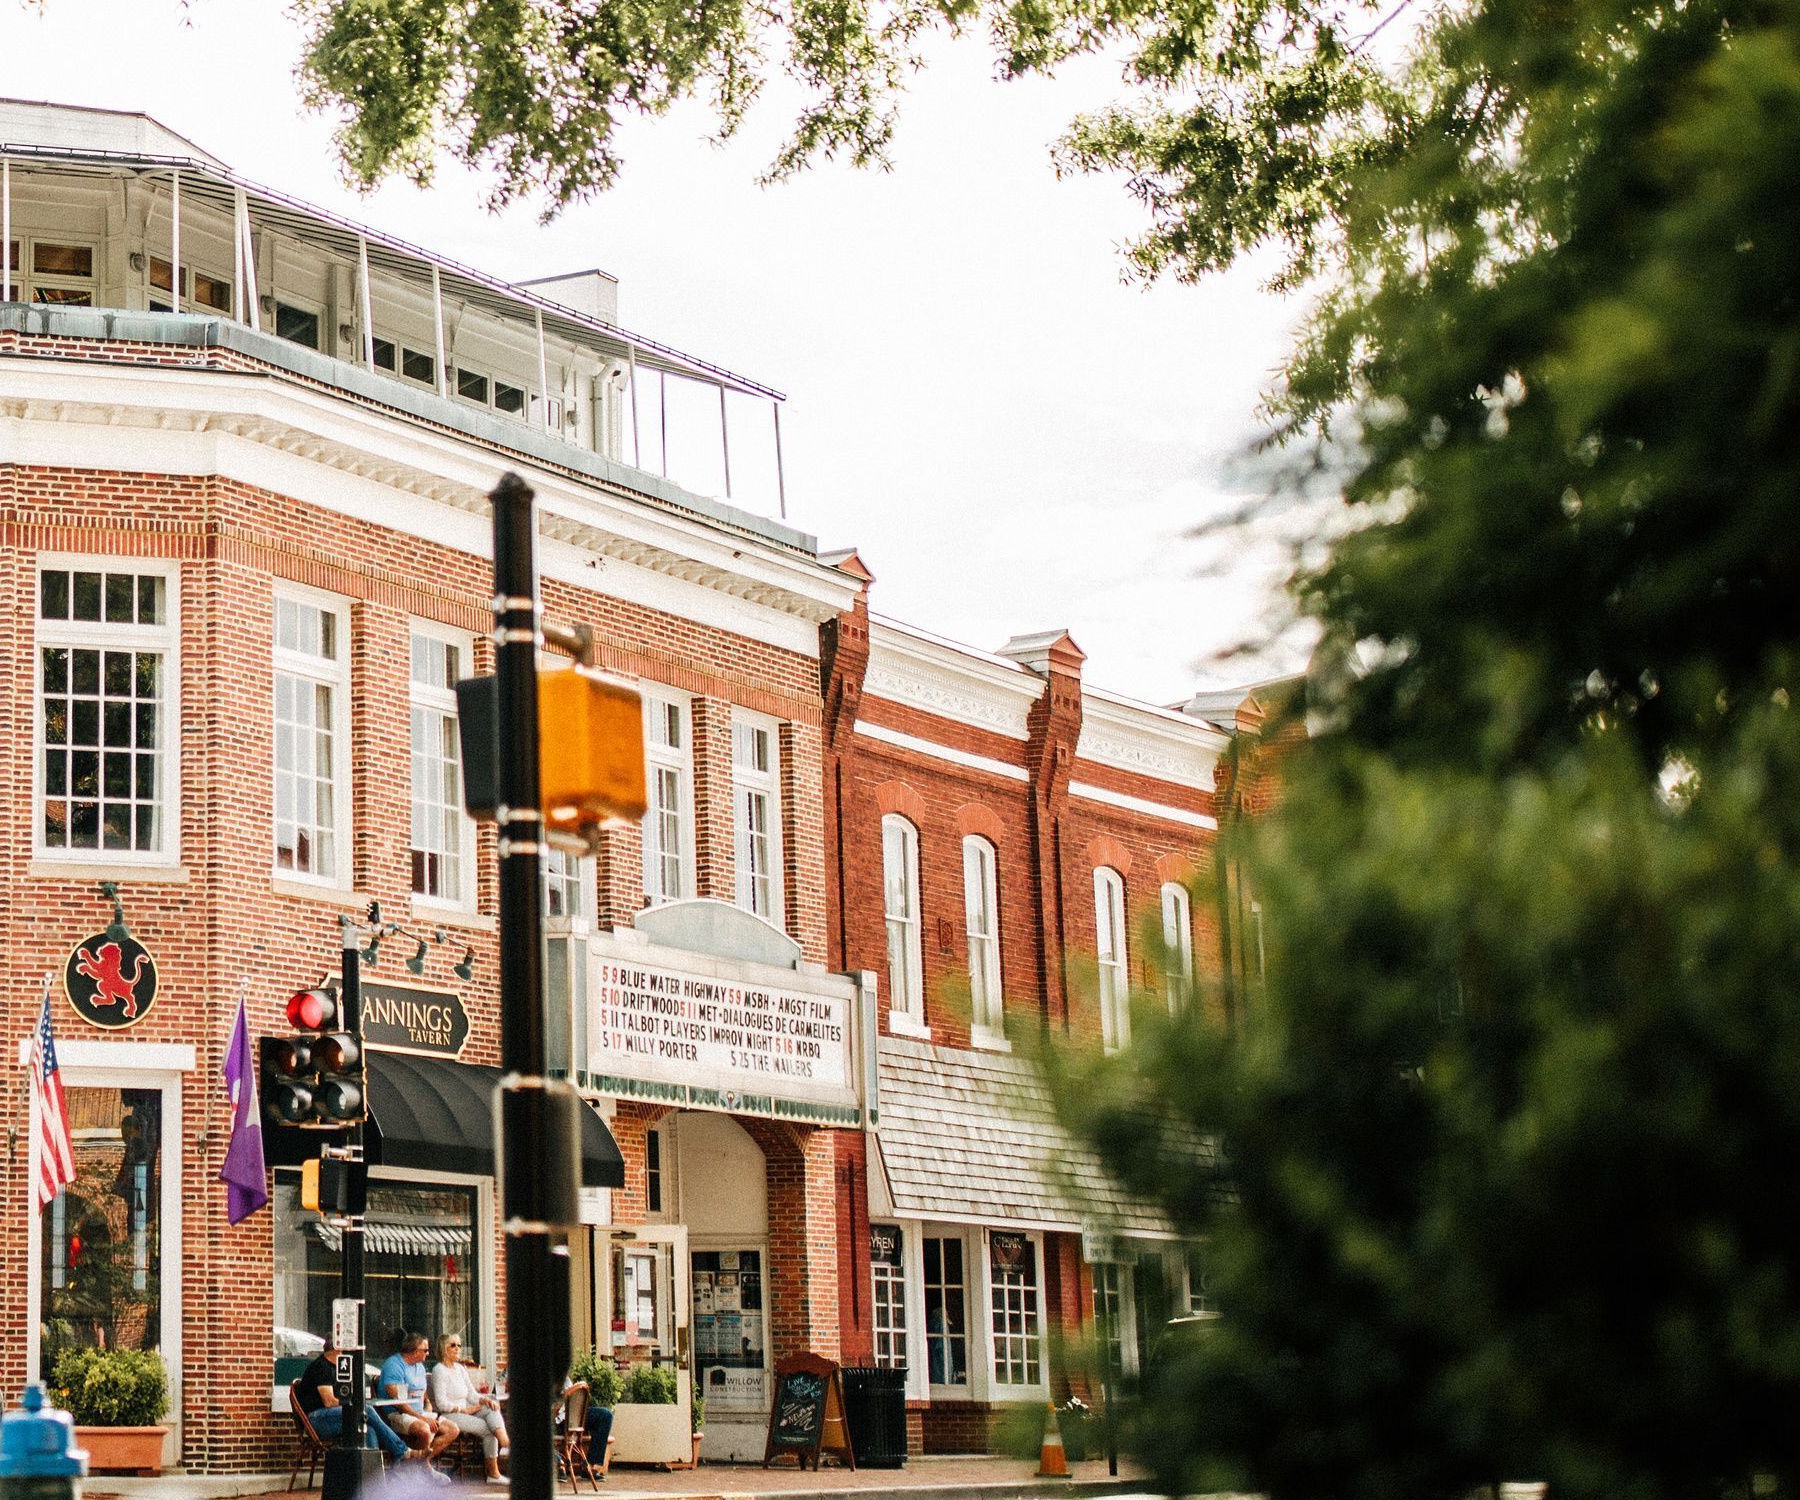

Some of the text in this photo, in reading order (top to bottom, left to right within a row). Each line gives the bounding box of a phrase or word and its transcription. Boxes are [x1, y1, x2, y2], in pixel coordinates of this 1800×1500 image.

[602, 965, 609, 982] 5
[611, 967, 618, 984] 9
[620, 968, 646, 990] BLUE
[649, 973, 680, 995] WATER
[684, 980, 727, 1003] HIGHWAY
[728, 988, 734, 1005] 5
[743, 990, 769, 1011] MSBH
[778, 996, 808, 1017] ANGST
[810, 1002, 832, 1021] FILM
[360, 996, 453, 1033] ANNINGS
[601, 987, 608, 1004] 5
[610, 988, 620, 1007] 10
[622, 990, 679, 1017] DRIFTWOOD
[680, 1000, 686, 1018] 5
[775, 1016, 787, 1034] DE
[789, 1018, 841, 1042] CARMELITES
[601, 1009, 608, 1026] 5
[621, 1012, 660, 1035] TALBOT
[663, 1019, 706, 1041] PLAYERS
[709, 1026, 743, 1047] IMPROV
[746, 1032, 773, 1053] NIGHT
[775, 1037, 781, 1053] 5
[796, 1039, 821, 1059] NRBQ
[408, 1028, 452, 1046] TAVERN
[602, 1030, 609, 1048] 5
[611, 1031, 622, 1050] 17
[625, 1034, 655, 1055] WILLY
[659, 1039, 698, 1062] PORTER
[730, 1050, 737, 1067] 5
[752, 1053, 769, 1072] THE
[869, 1235, 895, 1249] YREN
[727, 1377, 762, 1386] WILLOW
